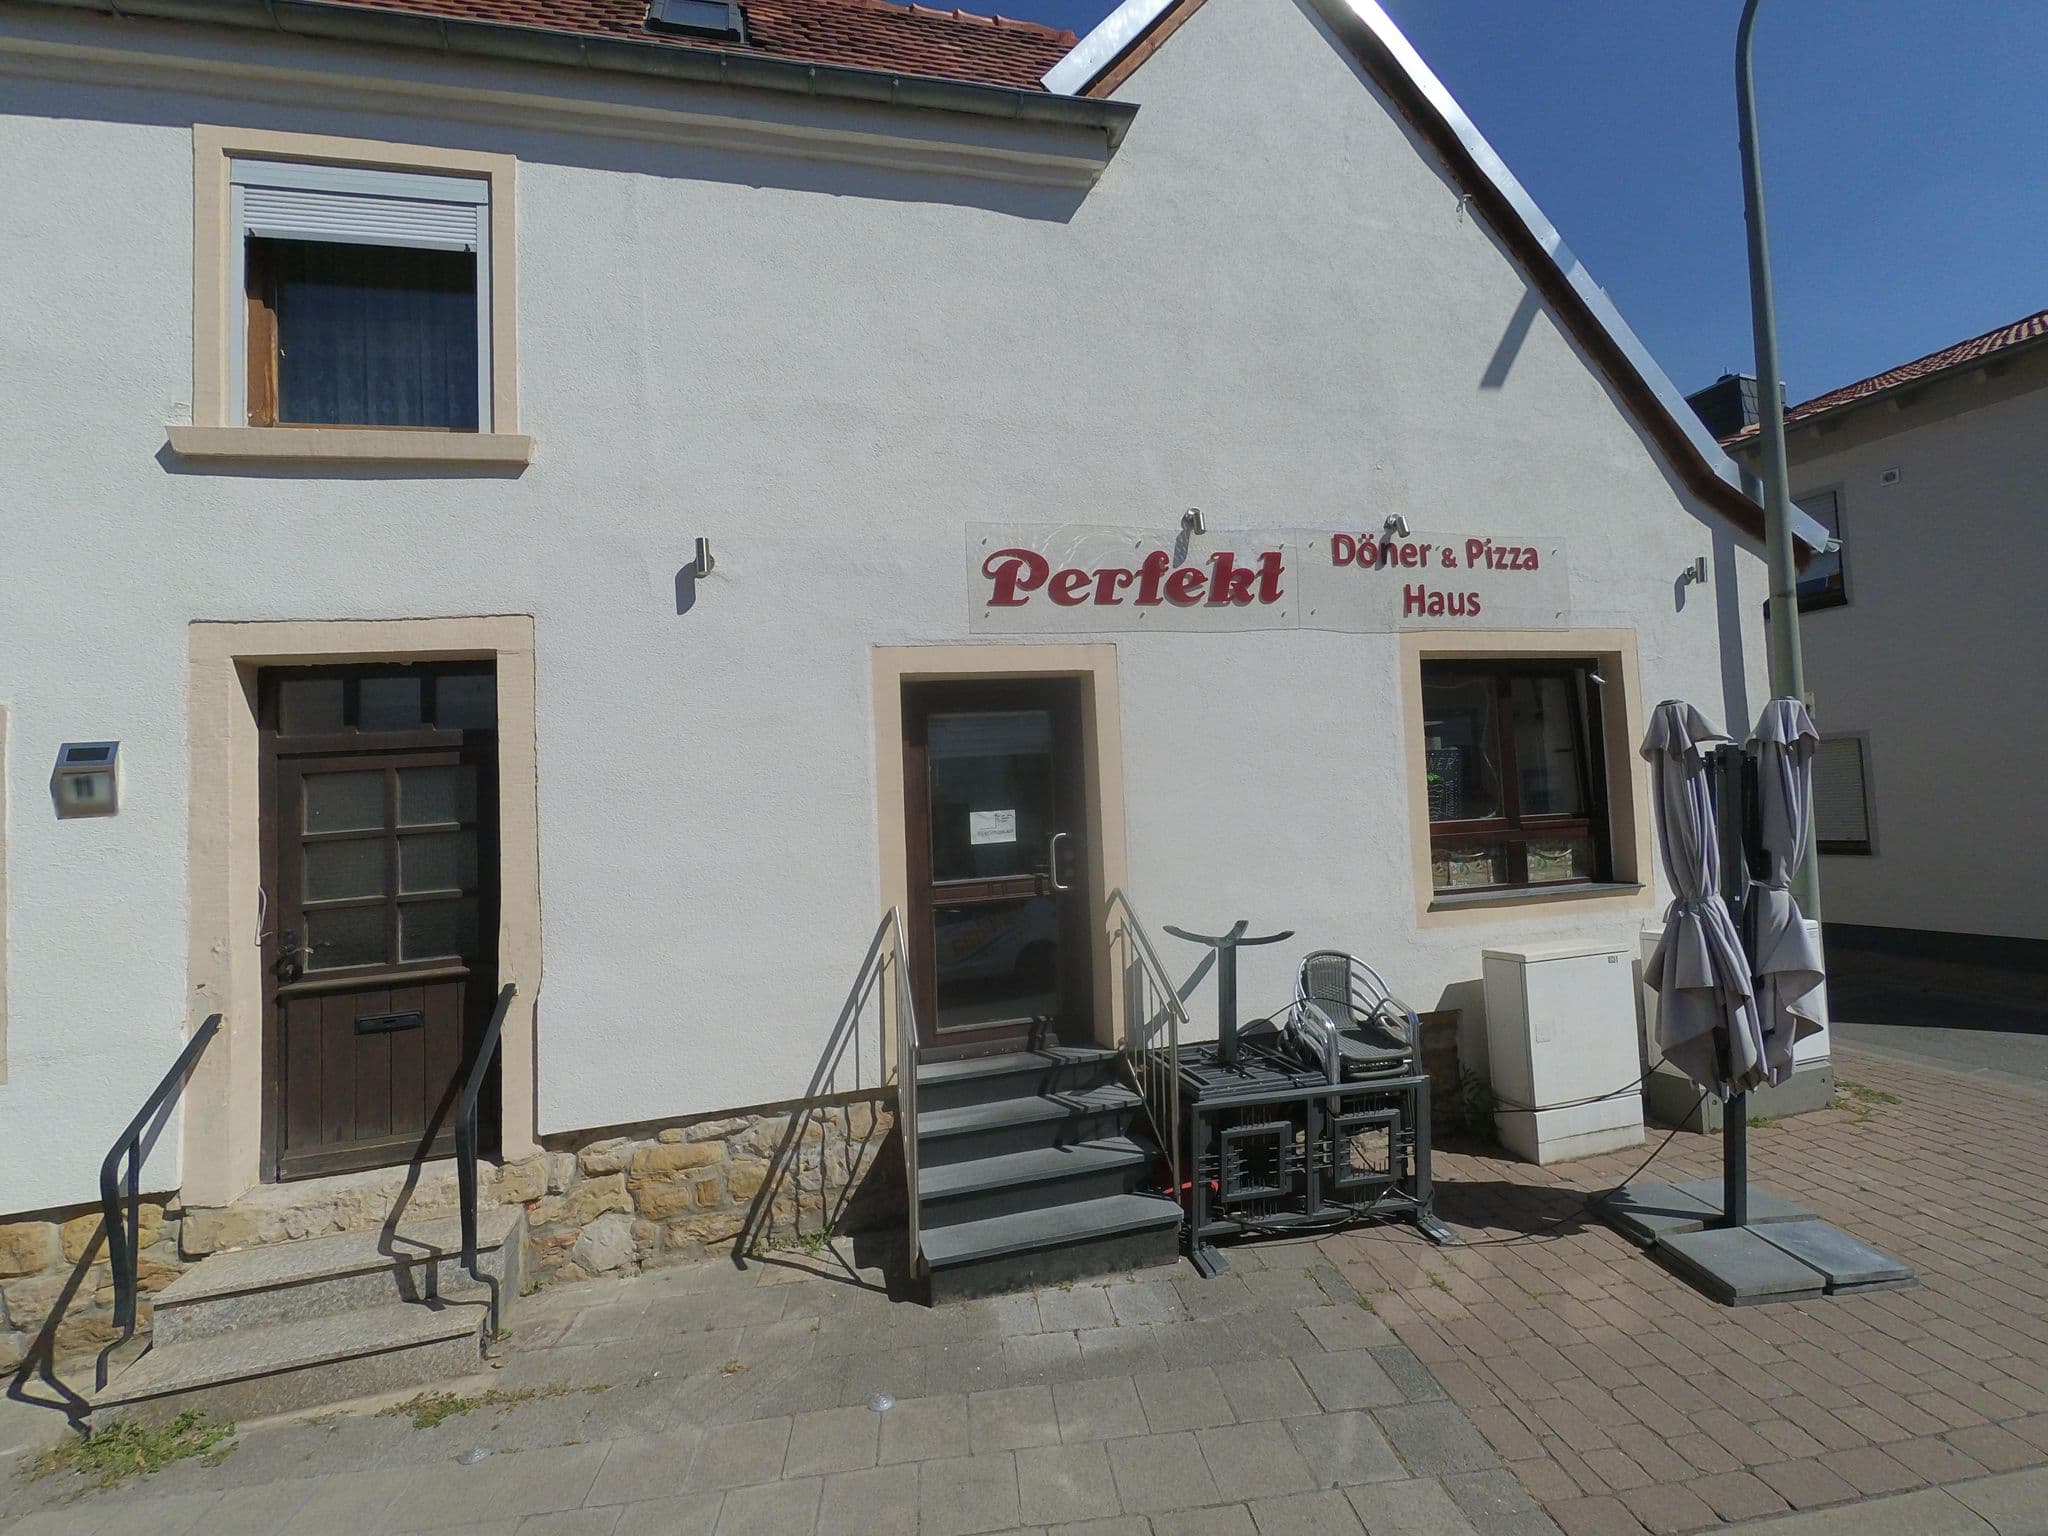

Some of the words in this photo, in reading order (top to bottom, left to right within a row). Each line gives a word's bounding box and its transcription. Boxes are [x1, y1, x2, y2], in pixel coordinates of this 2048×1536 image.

[1332, 533, 1432, 568] Döner
[1441, 547, 1458, 568] &
[1466, 538, 1540, 570] Pizza
[982, 548, 1286, 607] Perfekt
[1403, 583, 1482, 617] Haus
